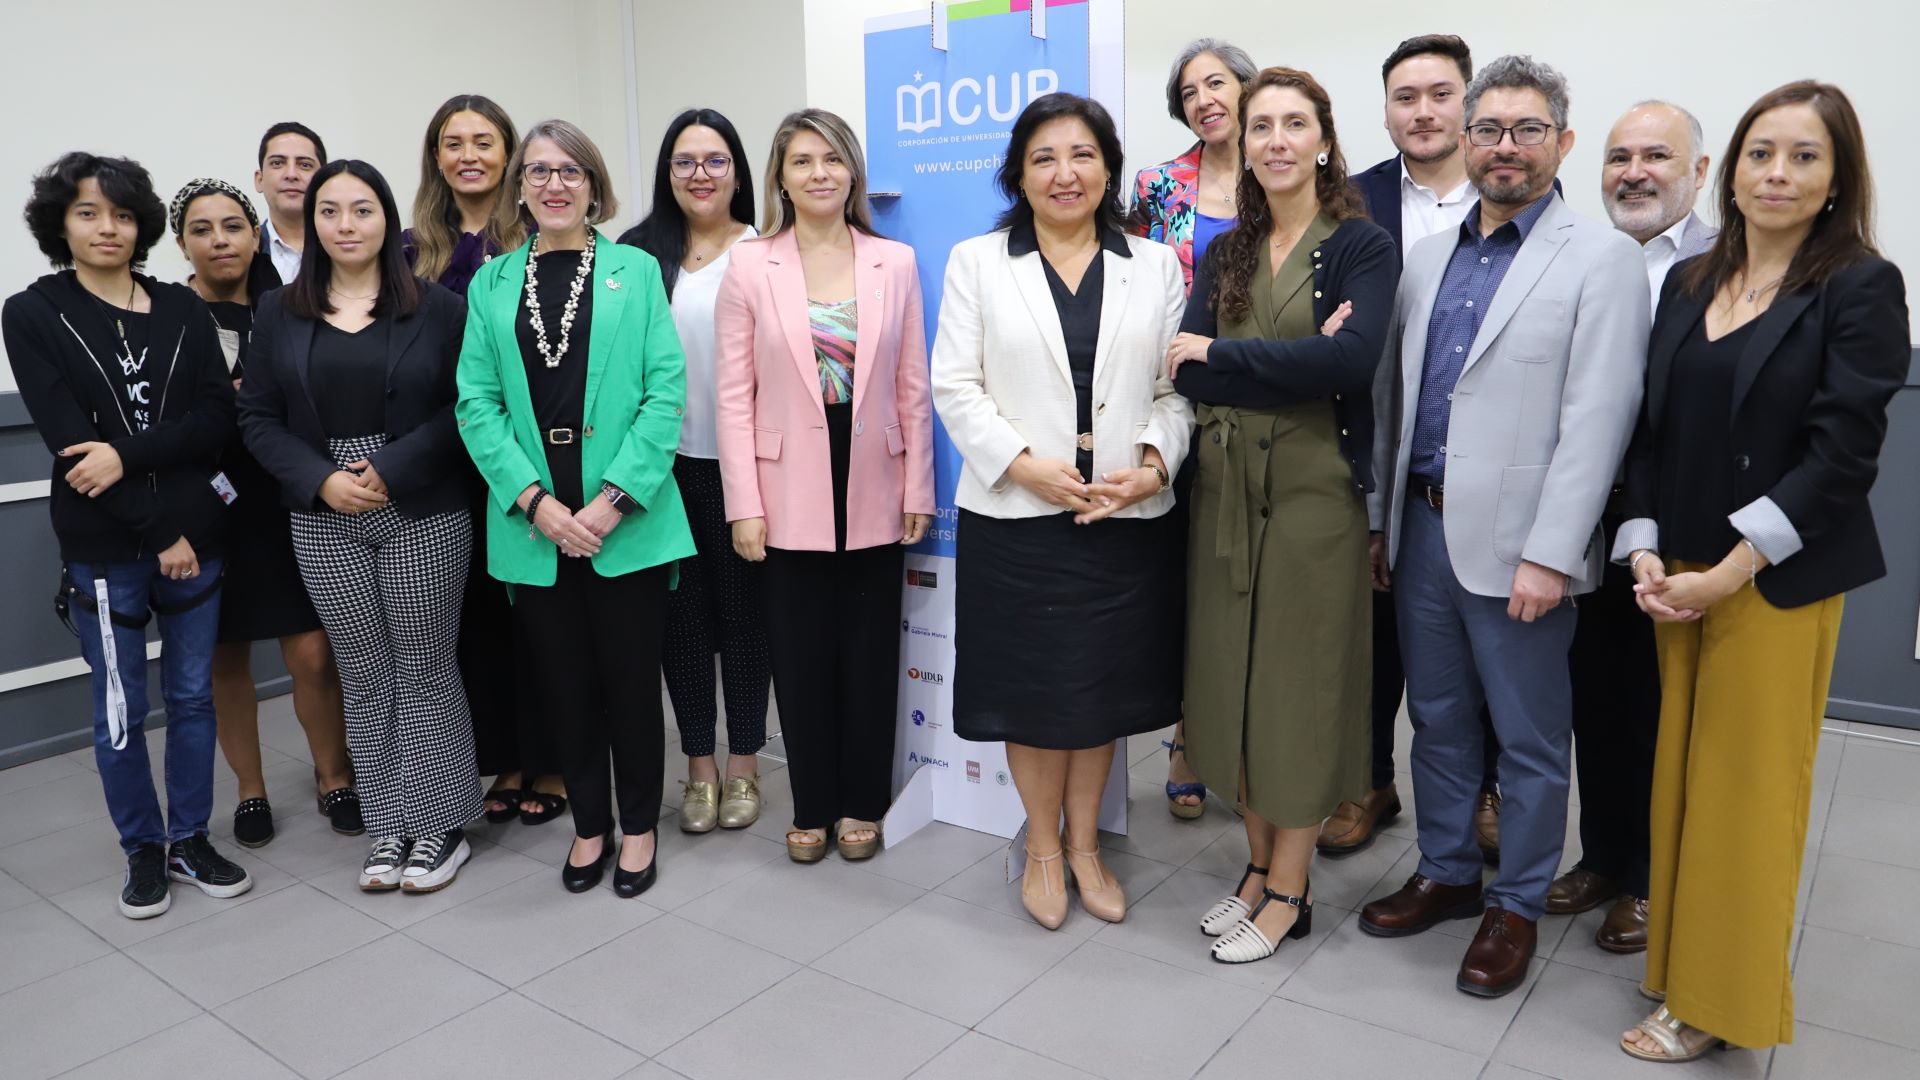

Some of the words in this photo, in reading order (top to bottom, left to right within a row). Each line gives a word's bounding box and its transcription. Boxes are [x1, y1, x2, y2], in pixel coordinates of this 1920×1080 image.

[897, 135, 949, 148] CORPORACIÓN
[951, 135, 961, 143] DE
[963, 131, 1013, 142] UNIVERSIDAD
[921, 670, 943, 683] UDLA
[920, 755, 949, 768] UNACH
